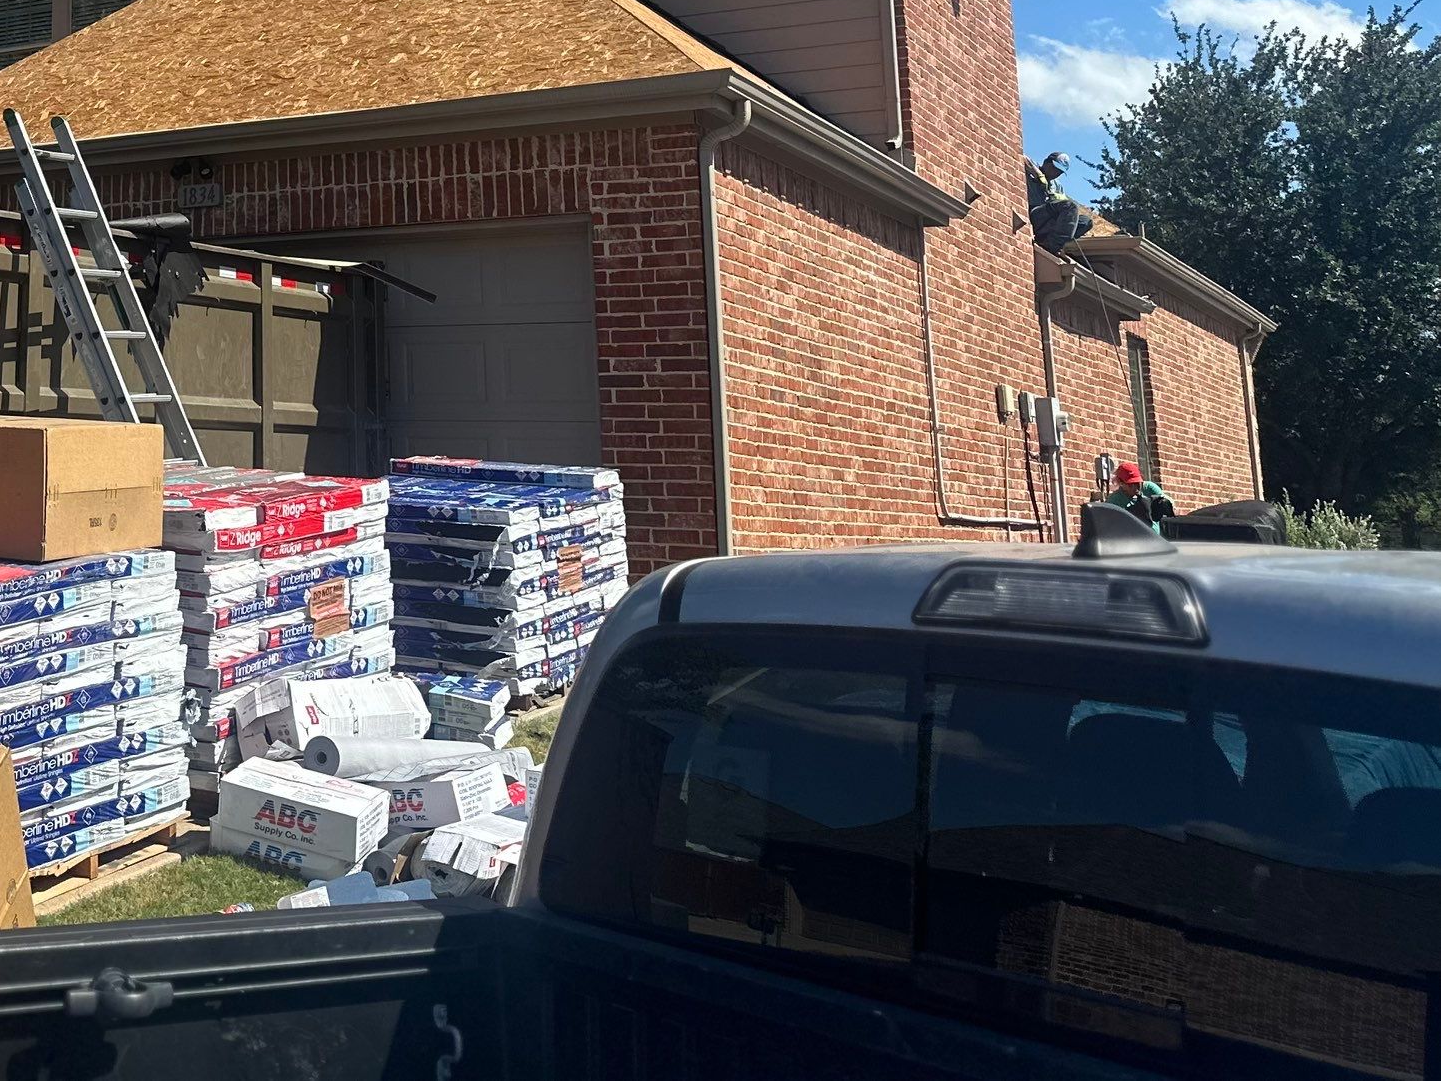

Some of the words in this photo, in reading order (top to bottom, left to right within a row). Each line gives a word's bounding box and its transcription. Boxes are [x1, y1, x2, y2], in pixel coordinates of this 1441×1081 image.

[183, 185, 216, 206] 1834
[236, 531, 262, 547] Ridge
[0, 635, 52, 652] Timberline
[14, 758, 57, 780] mberline
[57, 749, 80, 767] HDZ
[22, 820, 54, 839] berline
[54, 811, 77, 829] HDZ
[254, 799, 321, 834] ABC
[254, 822, 283, 838] Supply
[285, 831, 298, 841] Co.
